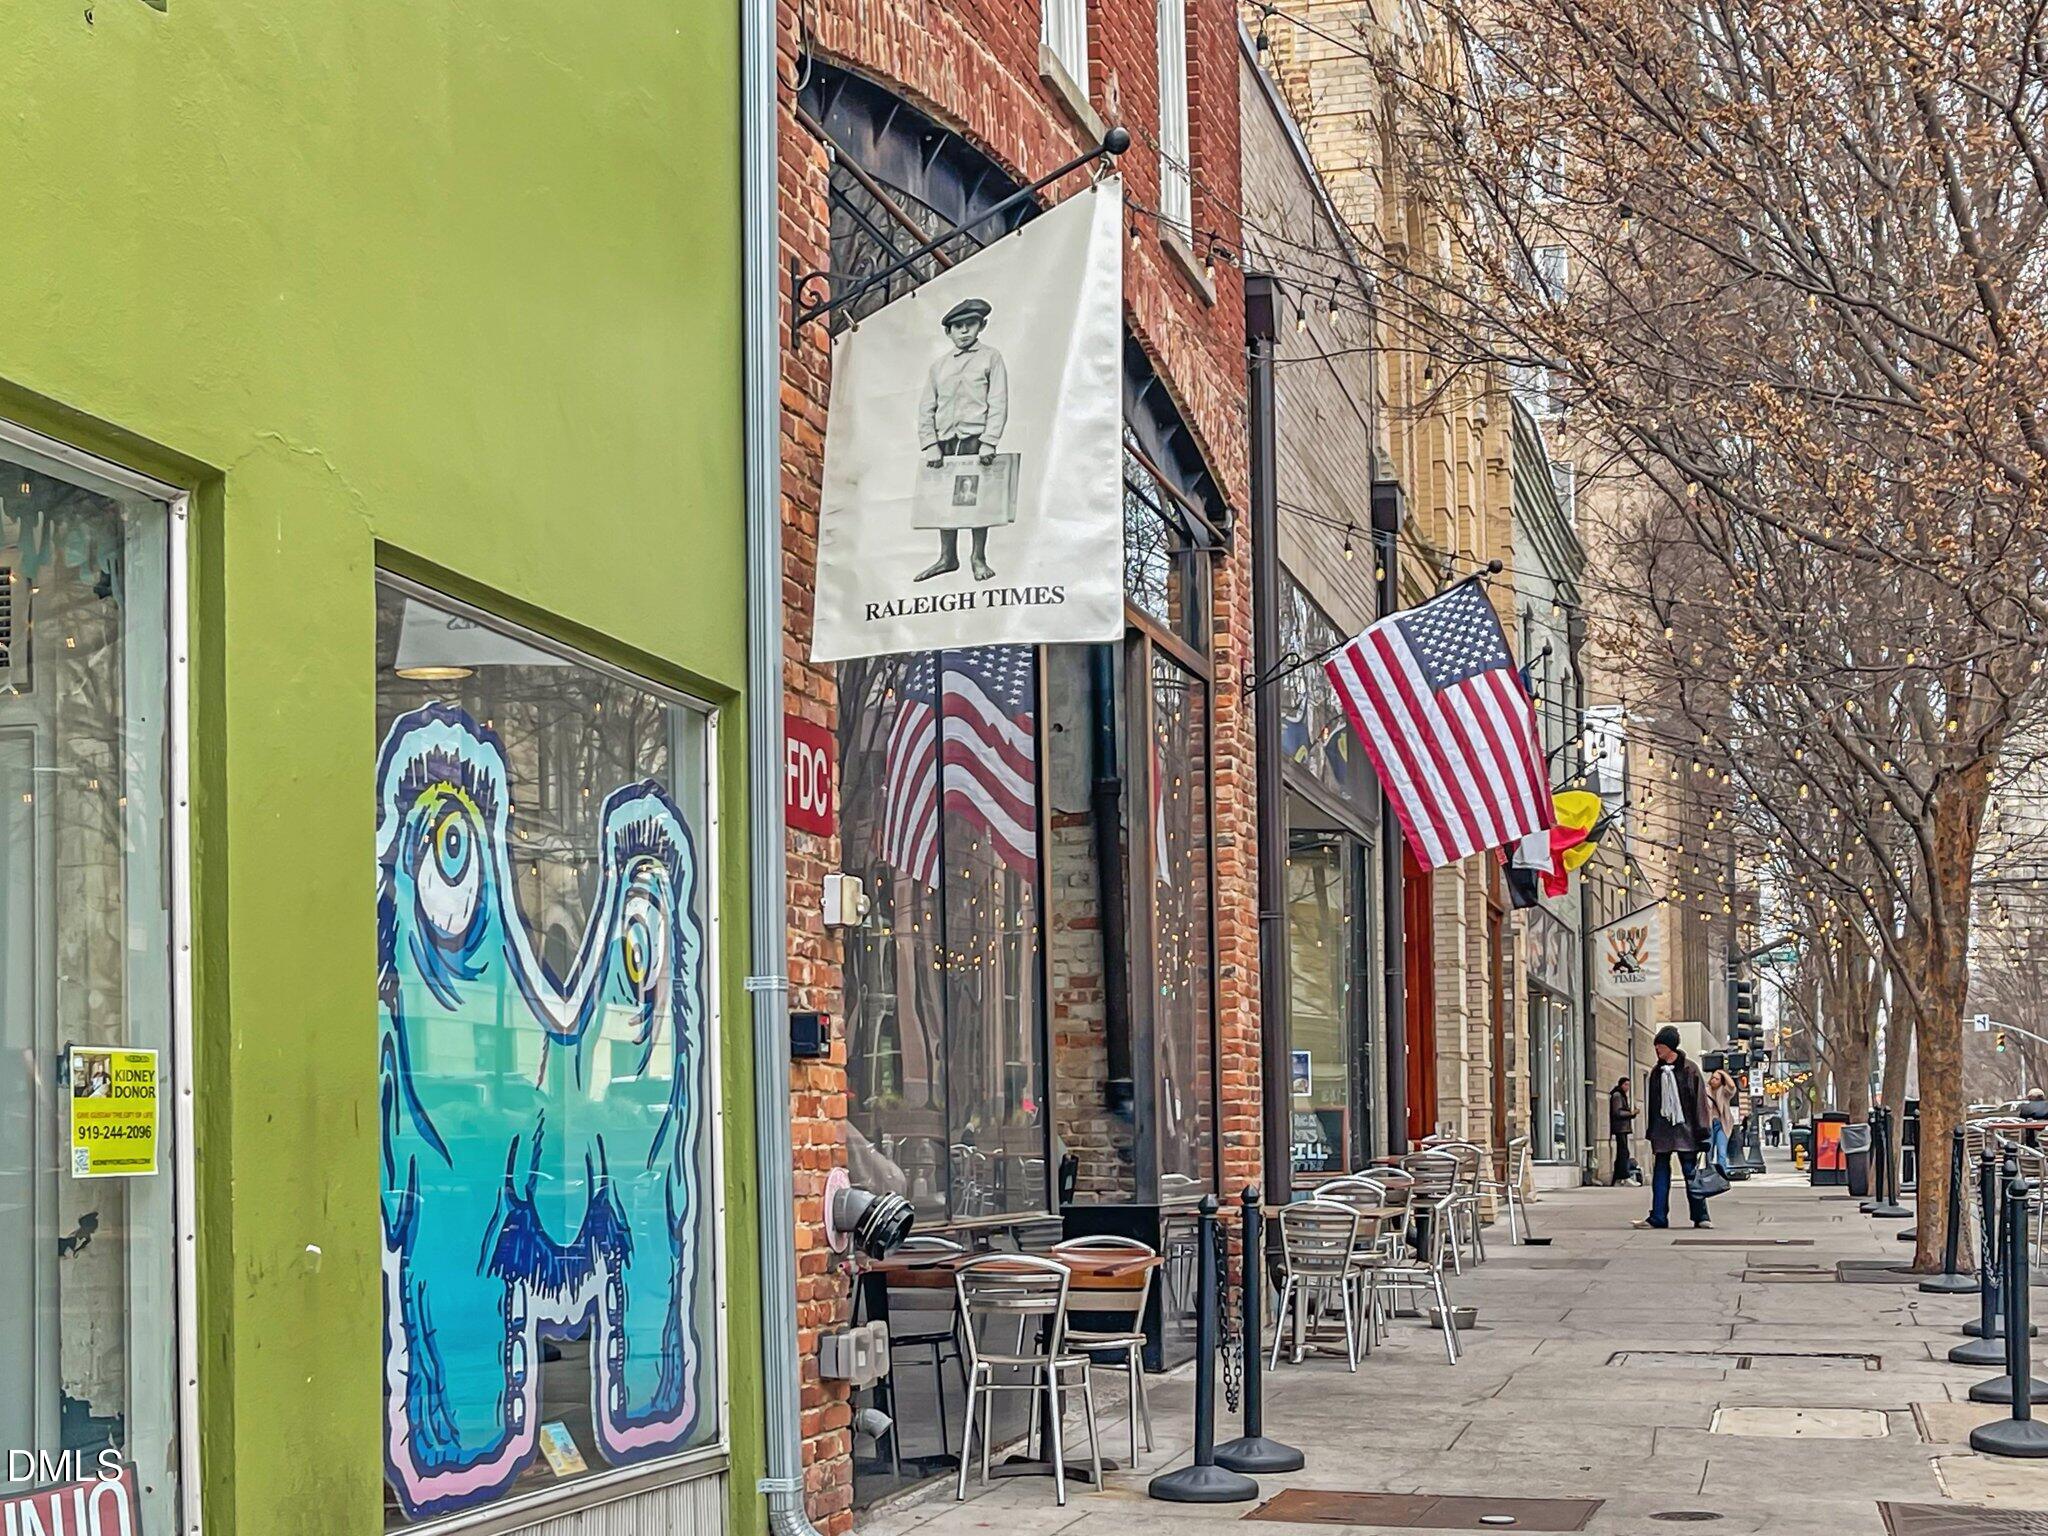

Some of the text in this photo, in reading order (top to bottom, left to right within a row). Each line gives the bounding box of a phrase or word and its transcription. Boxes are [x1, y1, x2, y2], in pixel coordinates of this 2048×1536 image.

[865, 586, 1065, 621] RALEIGH TIMES
[787, 737, 828, 817] FDC
[1613, 974, 1646, 984] TIMES
[115, 1069, 155, 1082] KIDNEY
[114, 1085, 156, 1099] DONOR
[78, 1125, 152, 1139] 919-244-2096
